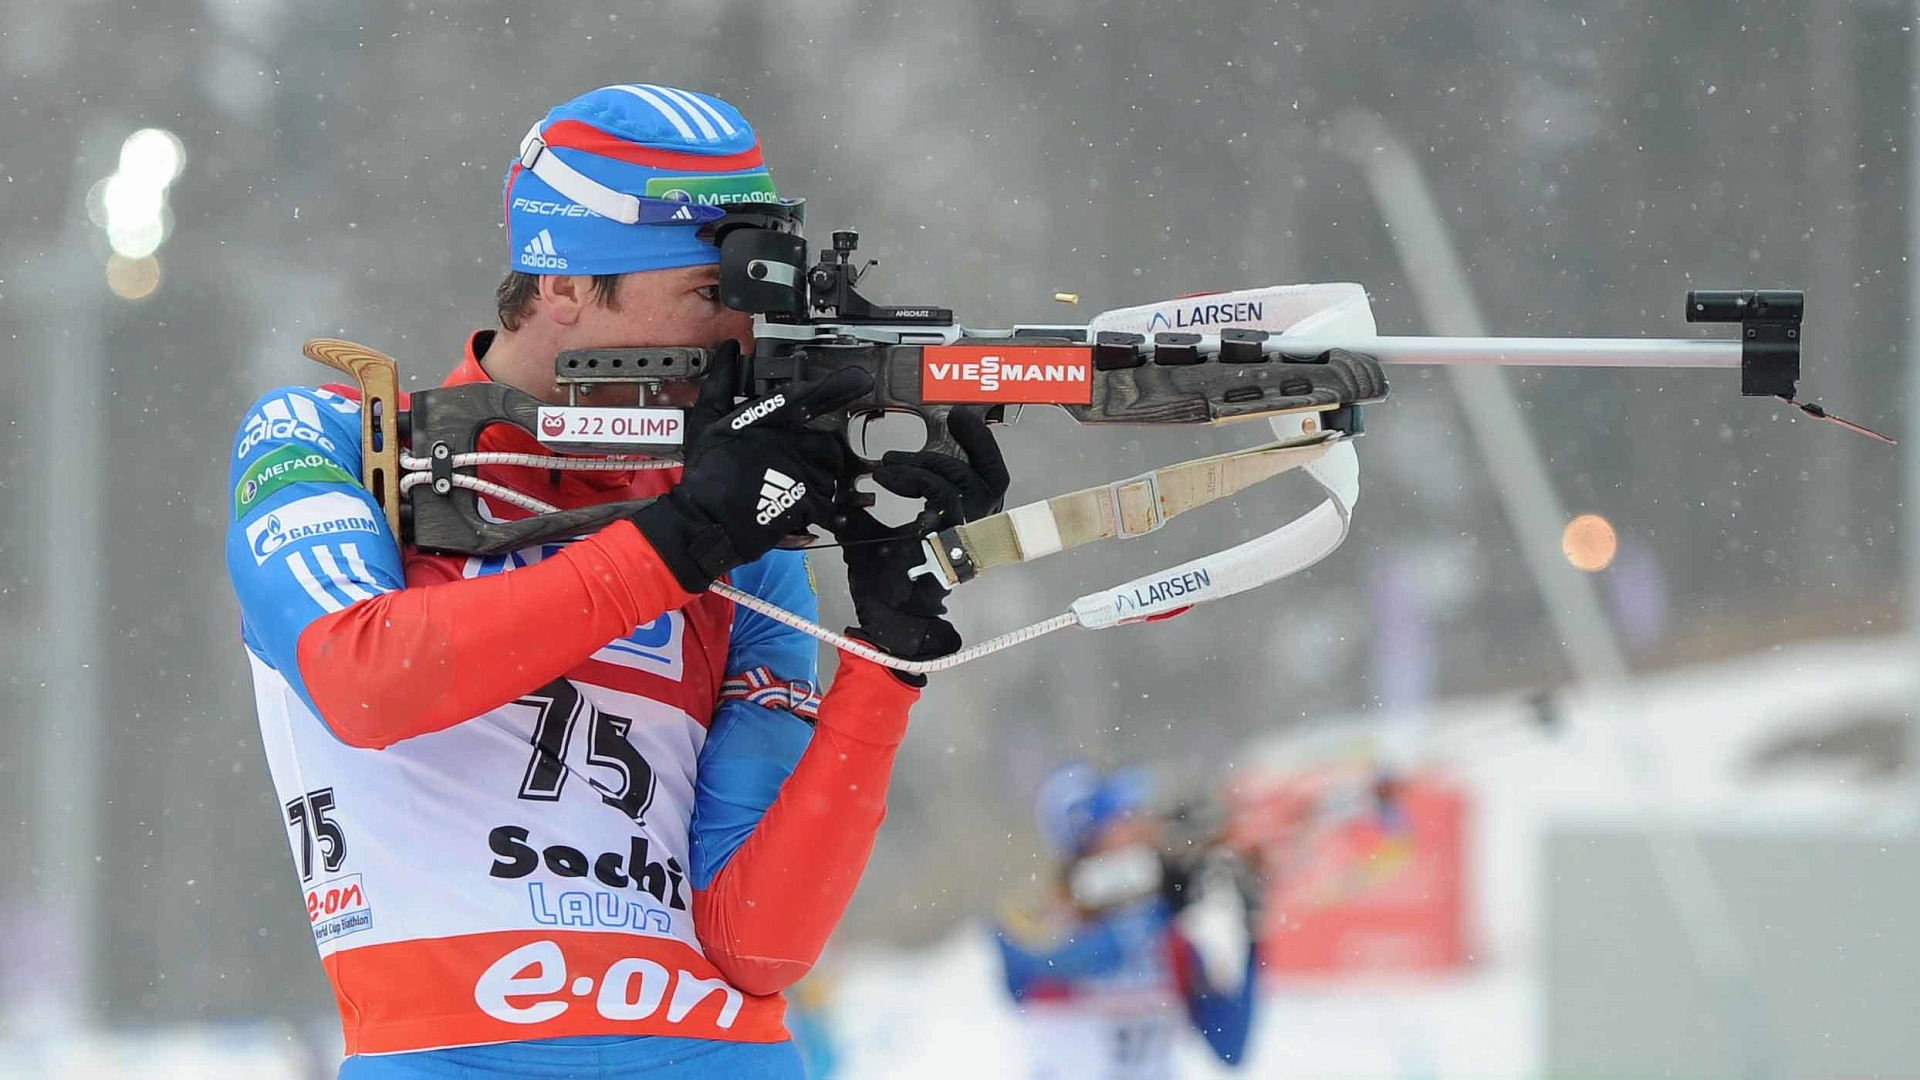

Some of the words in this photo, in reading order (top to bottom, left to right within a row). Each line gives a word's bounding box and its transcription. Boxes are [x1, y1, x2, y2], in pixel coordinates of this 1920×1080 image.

[521, 253, 568, 269] adidas
[1176, 302, 1262, 328] LARSEN
[928, 356, 1086, 391] VIESSMANN
[570, 416, 604, 435] .22
[611, 417, 679, 437] OLIMP
[731, 393, 785, 430] adidas
[258, 455, 339, 485] МЕГАФО
[756, 481, 807, 525] adidas
[289, 518, 377, 539] GAZPROM
[1134, 568, 1211, 607] LARSEN
[511, 676, 658, 826] 75
[286, 787, 347, 883] 75
[488, 826, 685, 911] Sochi
[341, 915, 369, 930] Biathlon
